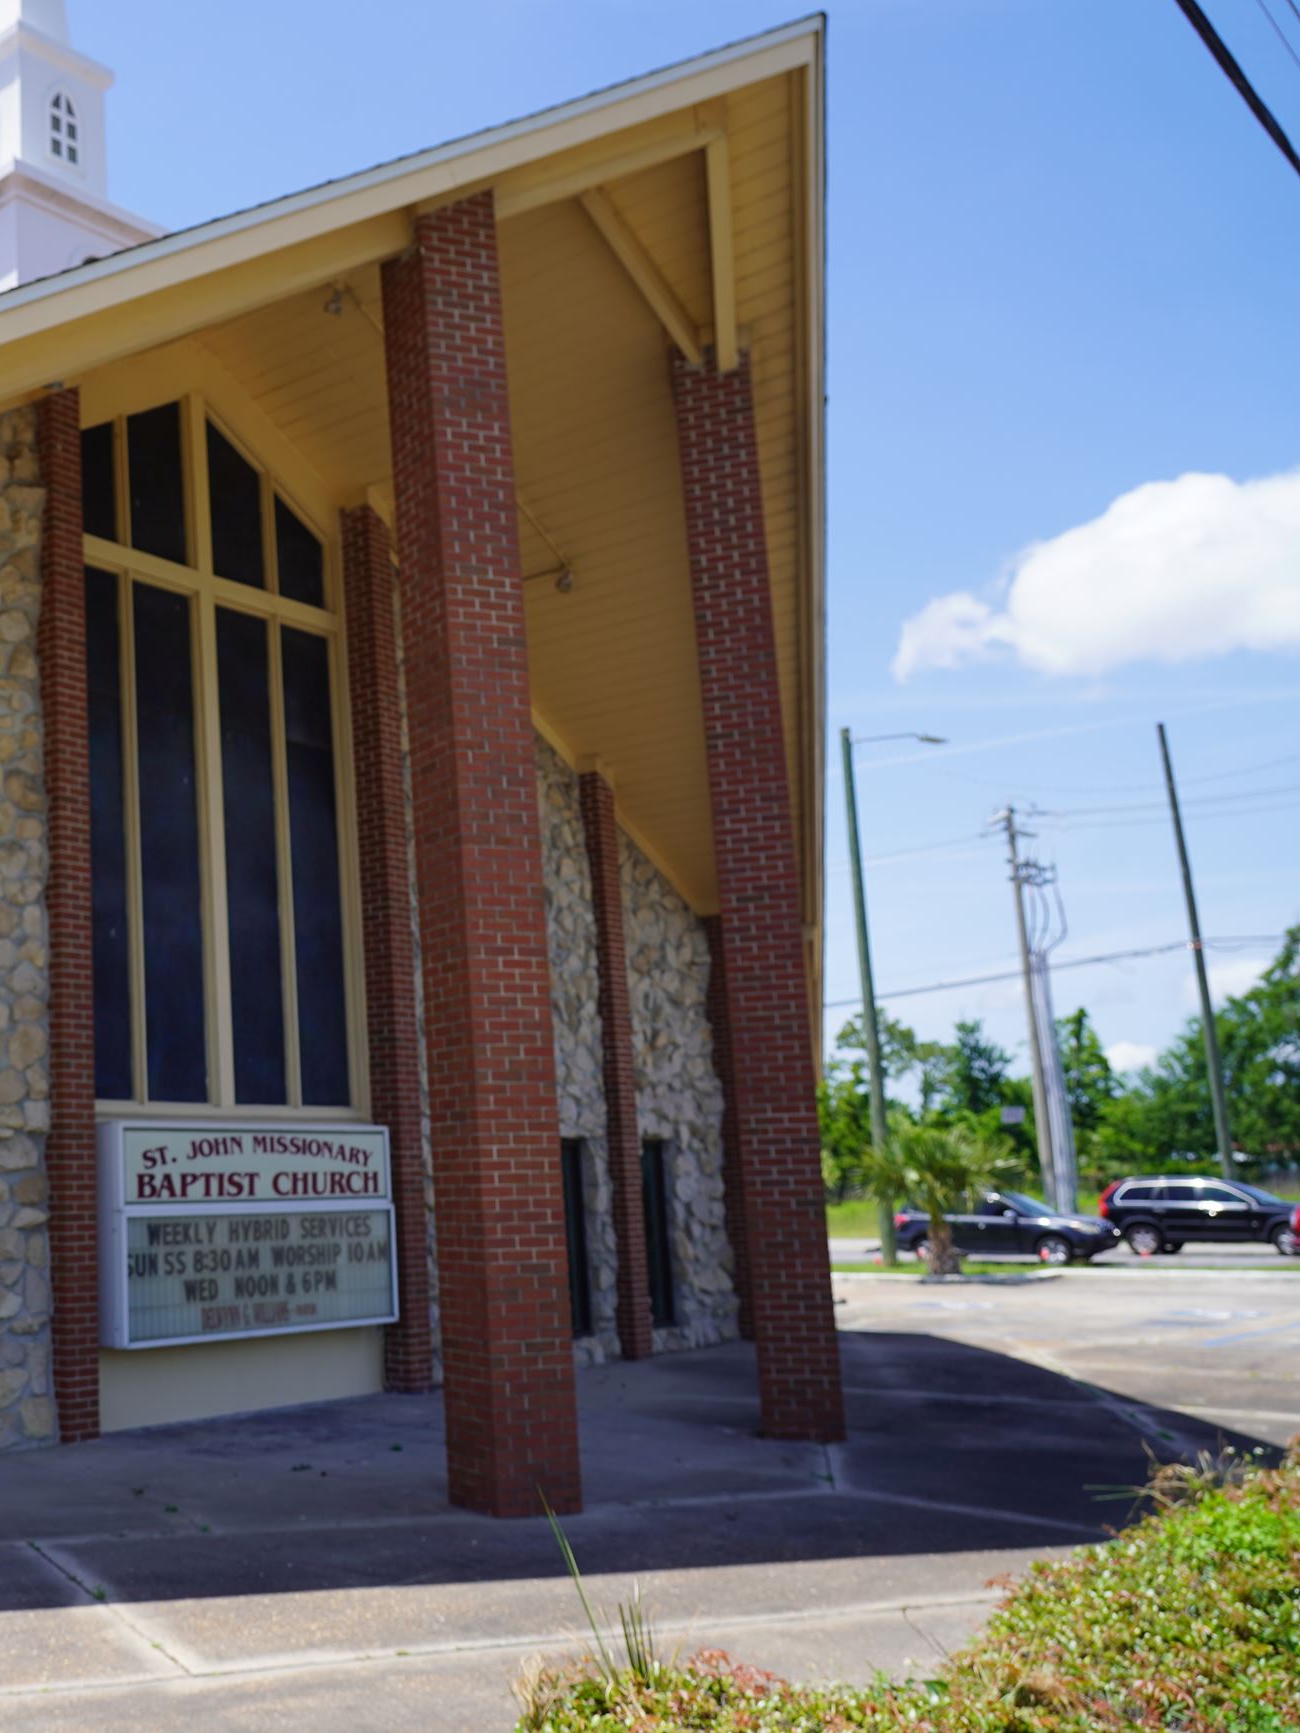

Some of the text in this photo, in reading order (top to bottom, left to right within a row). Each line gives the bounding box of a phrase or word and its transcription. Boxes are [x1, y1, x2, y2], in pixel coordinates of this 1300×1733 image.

[141, 1135, 374, 1170] ST. JOHN MISSIONARY
[136, 1171, 379, 1199] BAPTIST CHURCH
[146, 1216, 372, 1246] WEEKLY HYBRID SERVICES
[164, 1251, 187, 1275] SS
[272, 1244, 341, 1268] WORSHIP
[184, 1278, 219, 1303] WED
[234, 1274, 280, 1298] NOON
